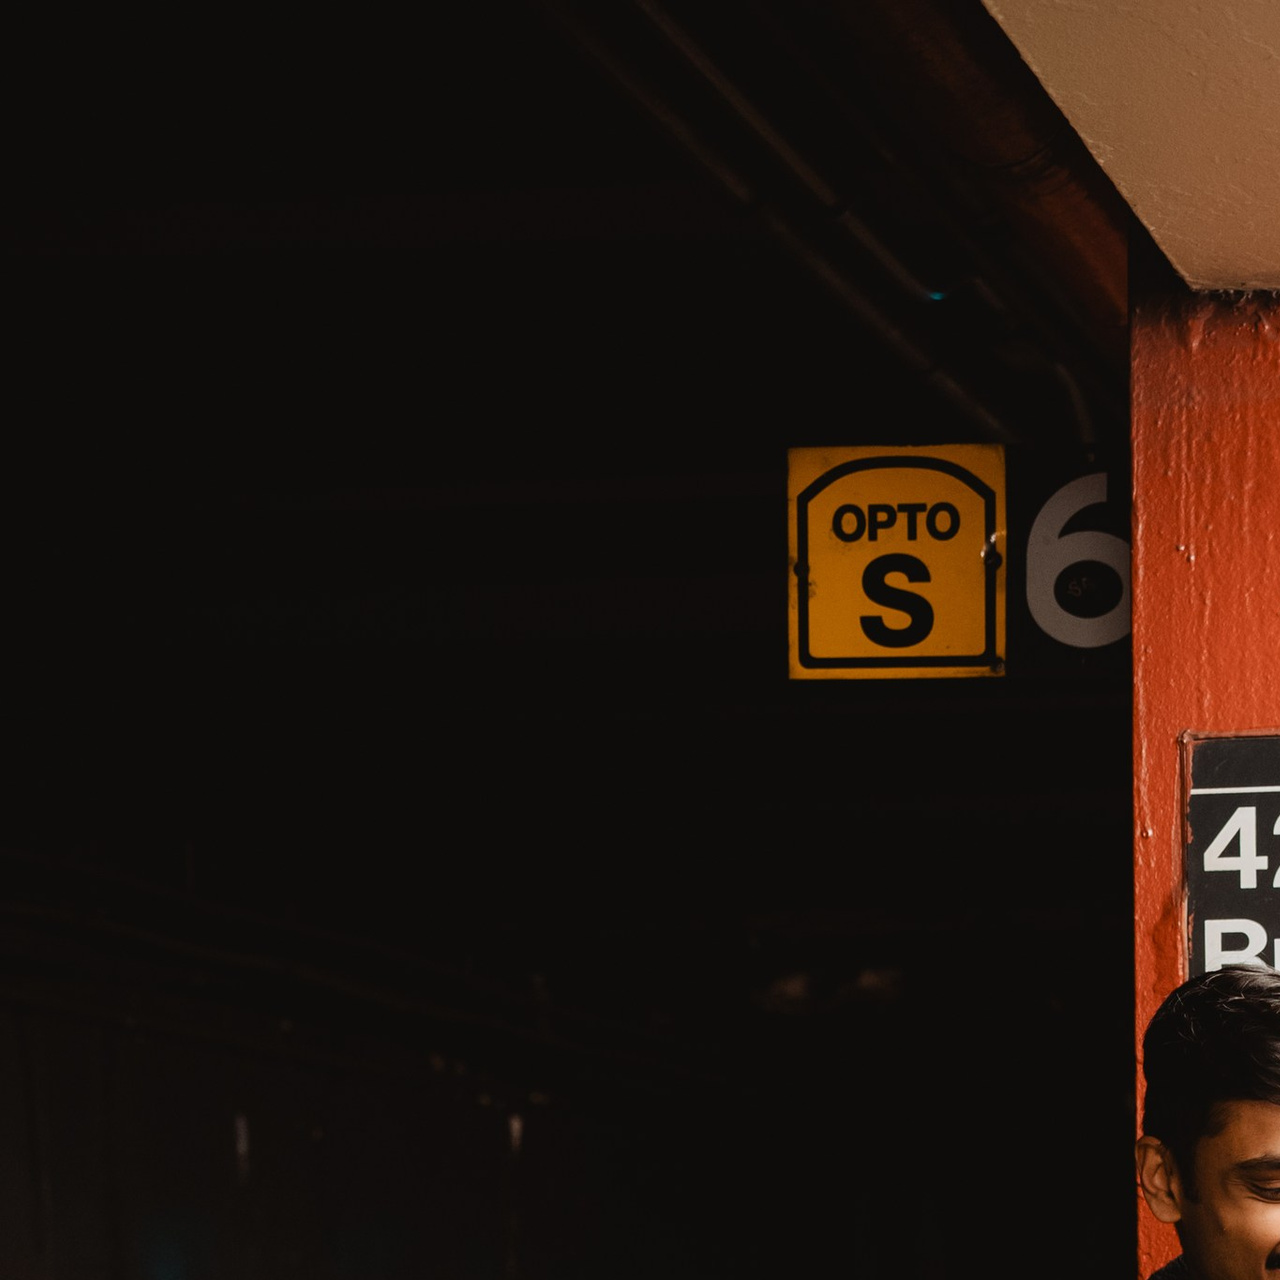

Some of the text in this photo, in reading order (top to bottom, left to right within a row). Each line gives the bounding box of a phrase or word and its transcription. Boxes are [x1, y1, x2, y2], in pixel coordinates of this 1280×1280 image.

[832, 503, 960, 542] OPTO
[1026, 472, 1131, 648] 6
[860, 553, 934, 647] S
